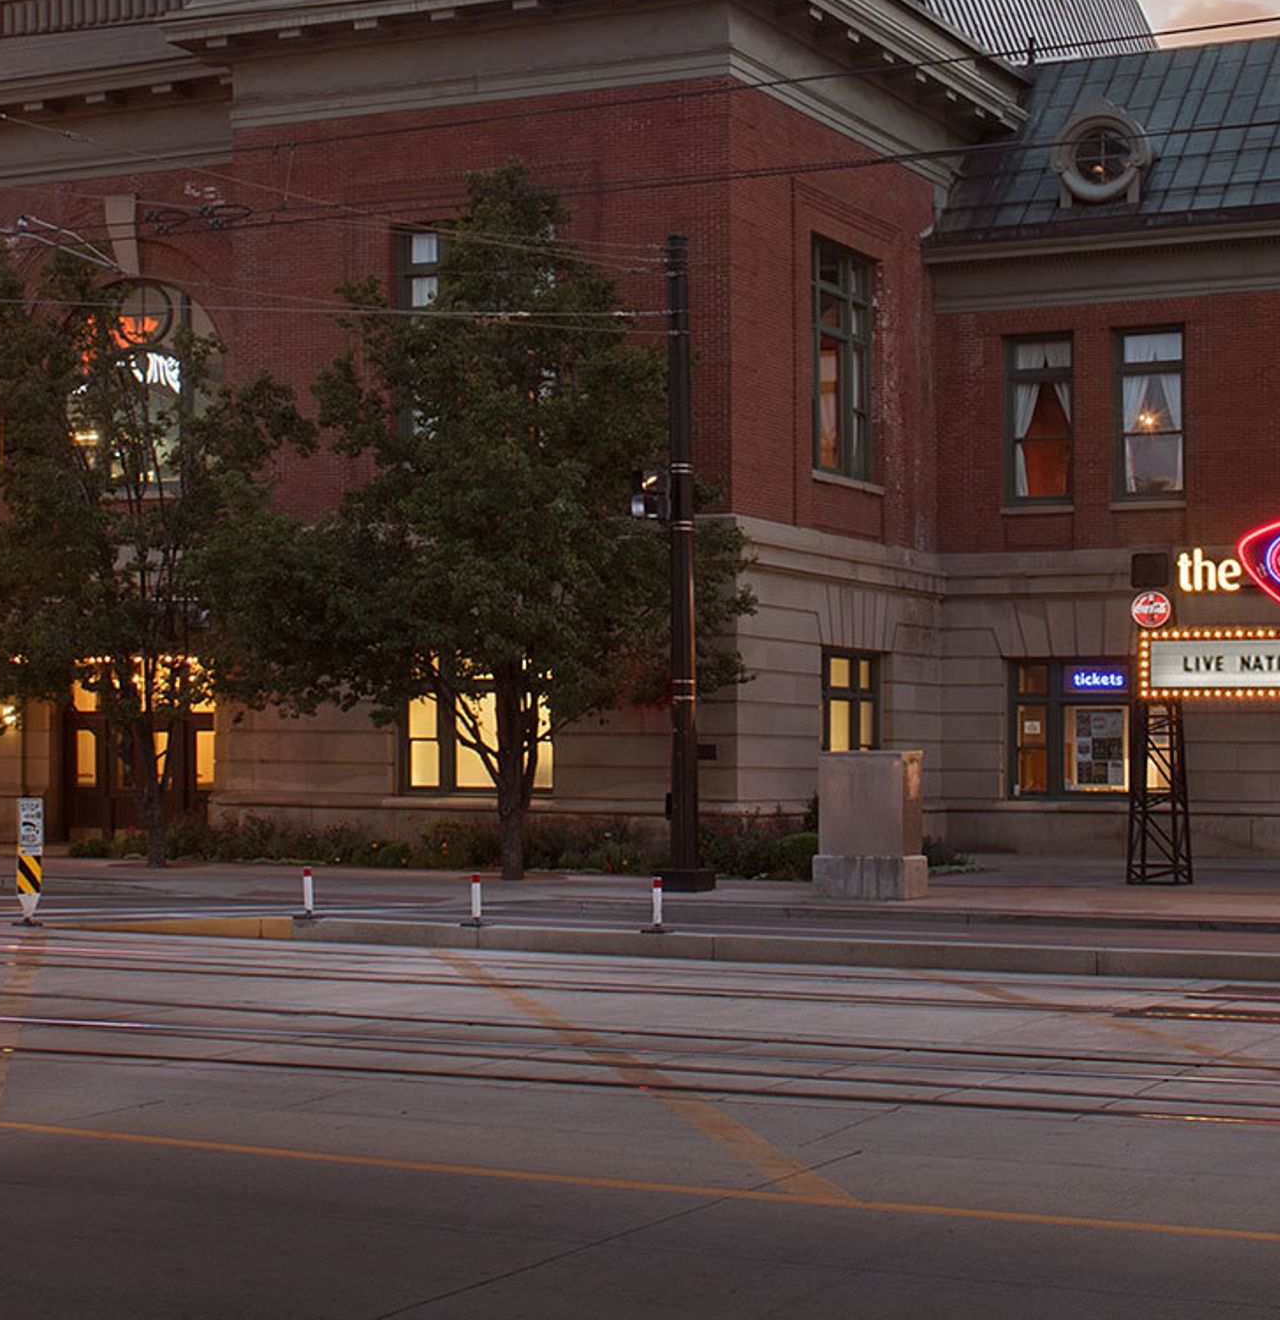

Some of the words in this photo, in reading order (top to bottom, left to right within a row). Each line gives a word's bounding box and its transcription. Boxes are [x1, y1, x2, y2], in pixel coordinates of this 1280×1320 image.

[1177, 547, 1241, 592] the
[1183, 654, 1224, 673] LIVE
[1074, 672, 1123, 686] tickets
